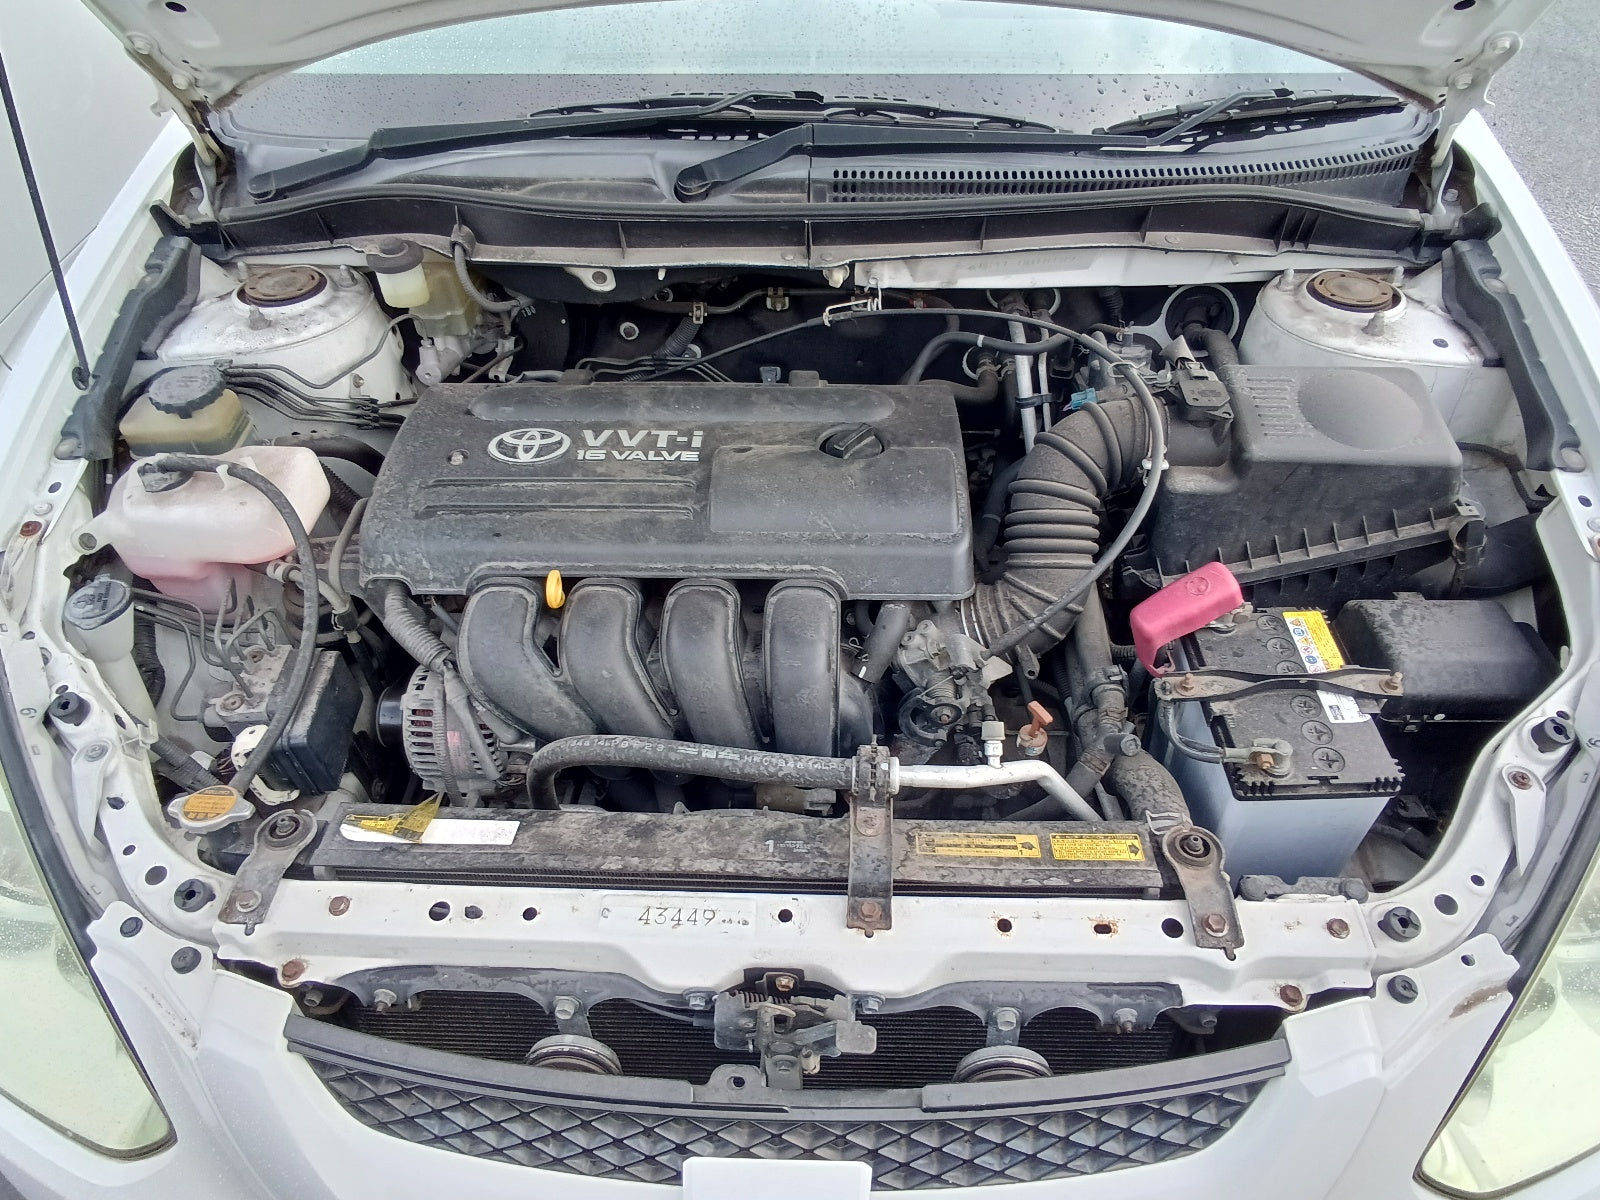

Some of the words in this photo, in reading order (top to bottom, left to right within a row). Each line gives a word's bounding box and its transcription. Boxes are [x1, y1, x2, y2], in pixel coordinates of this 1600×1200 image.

[582, 429, 703, 448] VVT-i
[577, 450, 607, 461] 16
[612, 450, 699, 462] VALVE
[638, 905, 716, 926] 43449
